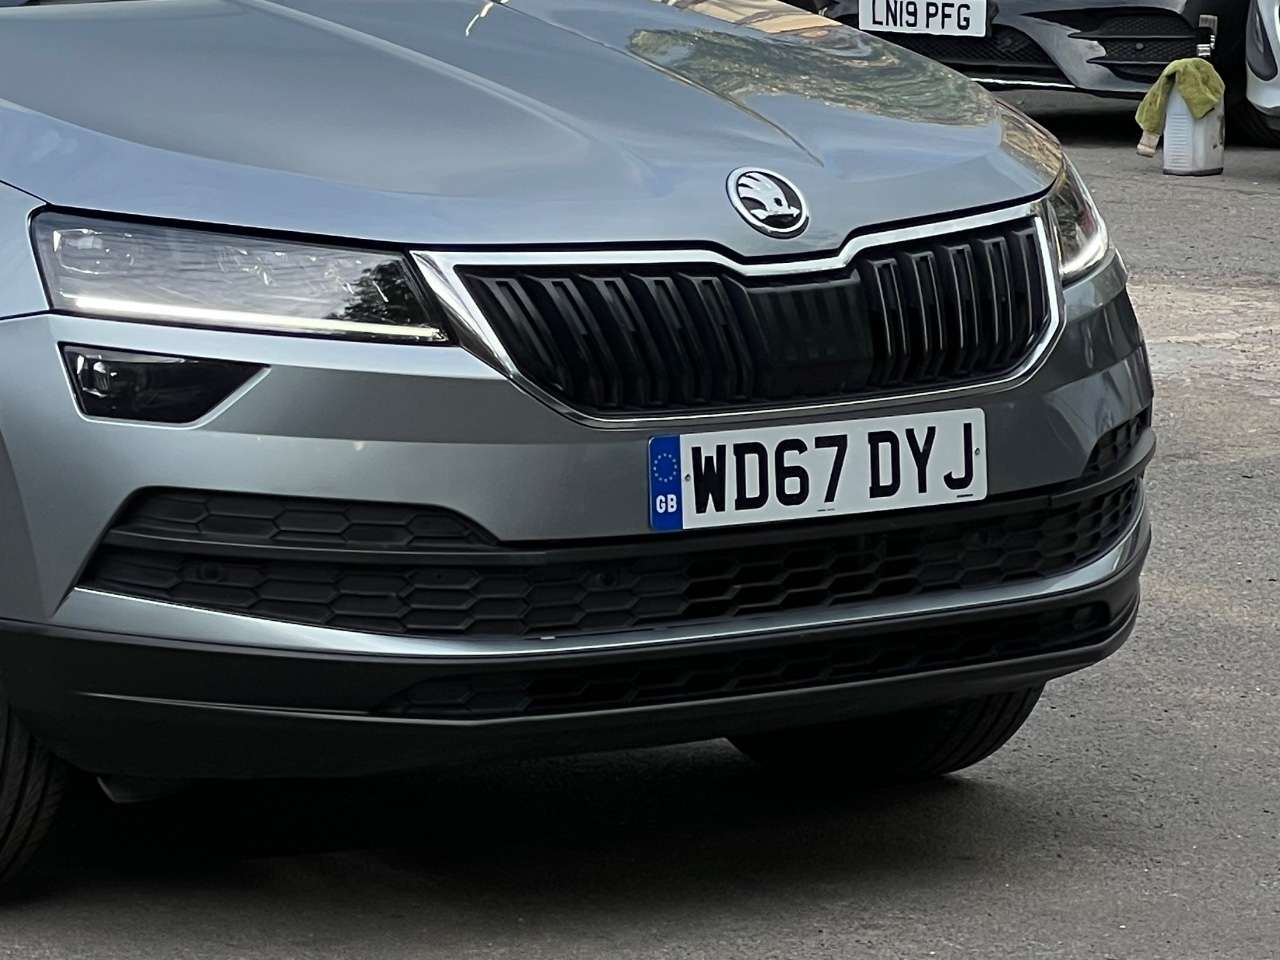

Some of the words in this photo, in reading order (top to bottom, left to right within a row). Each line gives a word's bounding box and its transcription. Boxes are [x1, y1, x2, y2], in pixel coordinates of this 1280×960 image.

[925, 0, 971, 31] PFG
[691, 434, 848, 515] WD67
[867, 422, 974, 500] DYJ
[655, 493, 678, 515] GB
